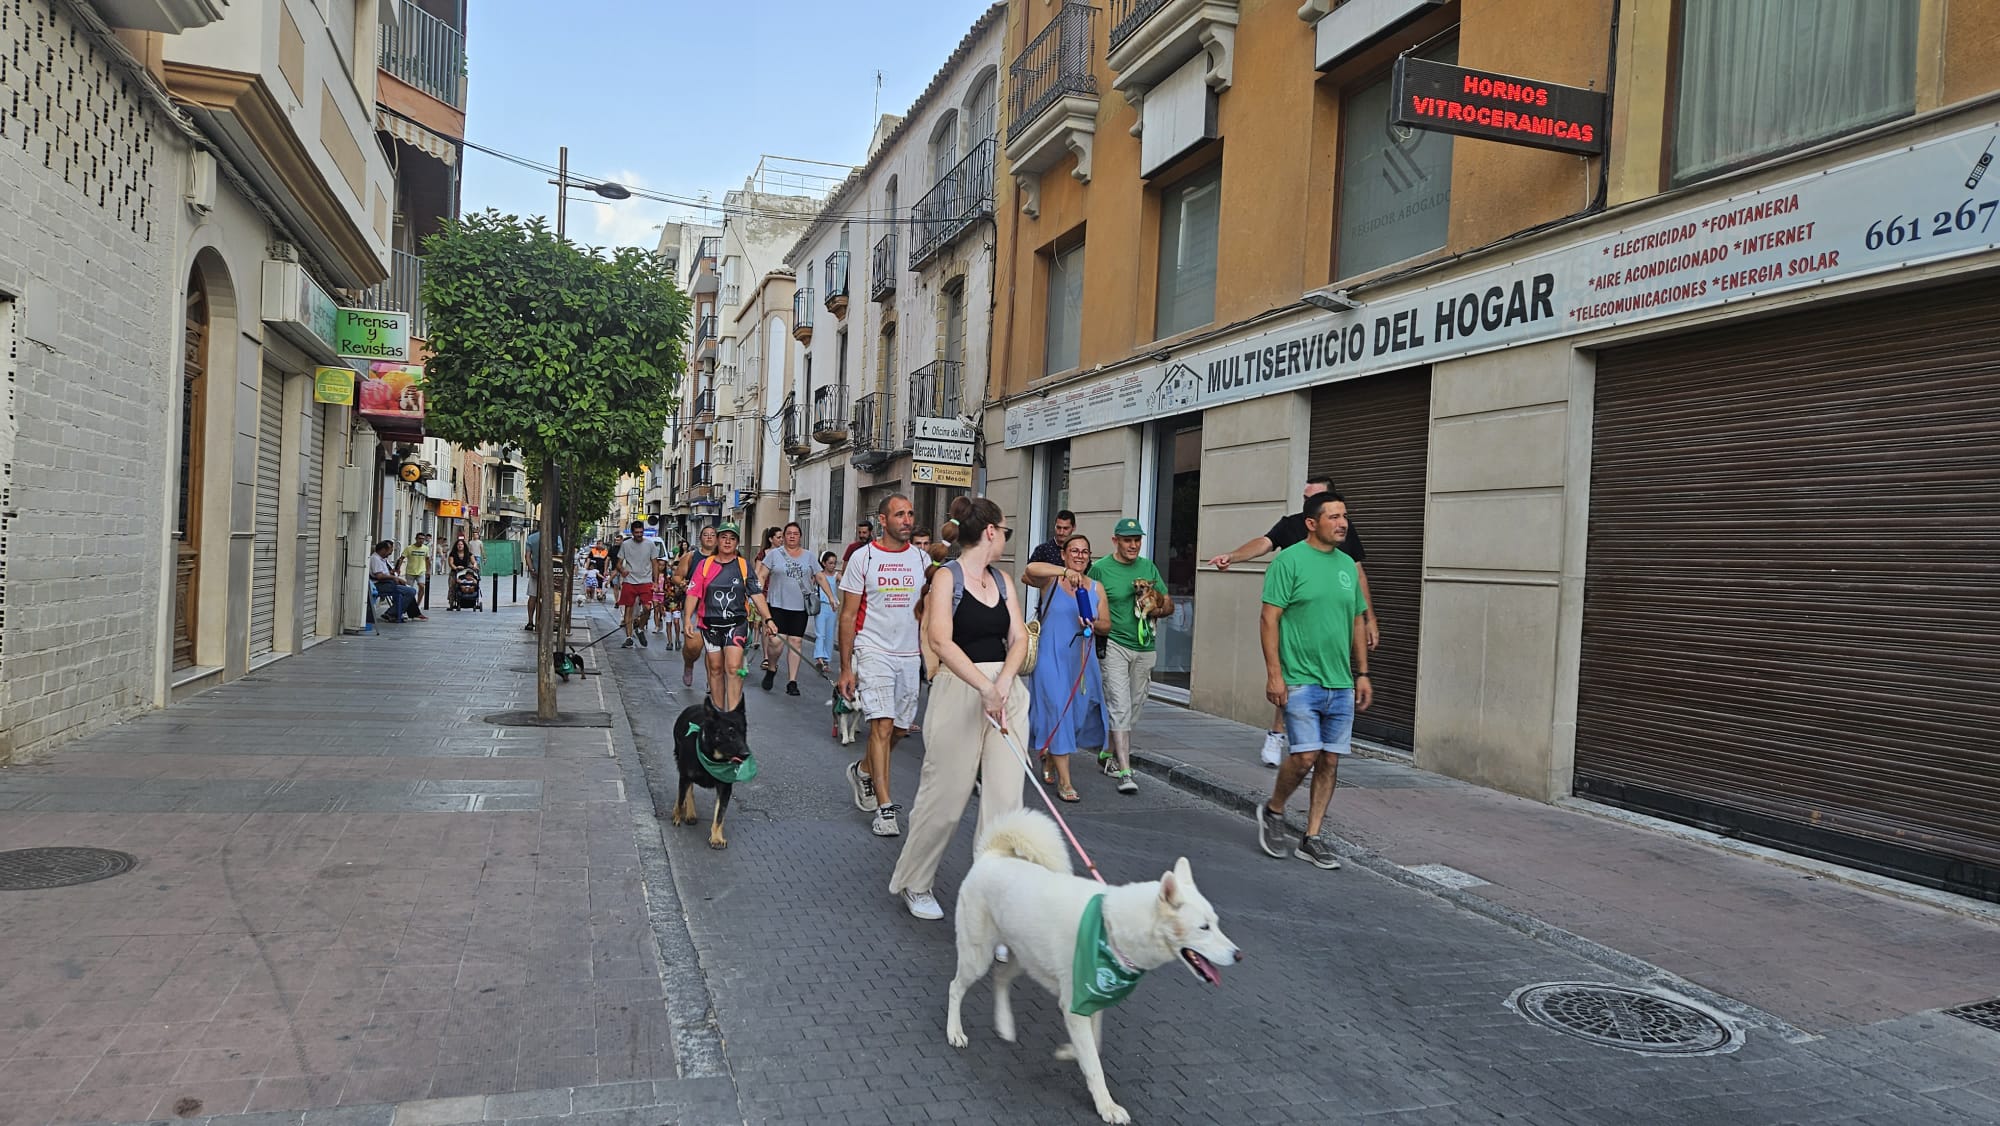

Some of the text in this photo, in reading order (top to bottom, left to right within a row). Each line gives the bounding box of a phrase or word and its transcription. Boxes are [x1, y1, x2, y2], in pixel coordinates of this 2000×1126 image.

[1463, 75, 1548, 107] HORNOS
[1412, 95, 1594, 143] VITROCERAMICAS
[1865, 198, 2000, 251] 661 267
[1613, 223, 1697, 259] ELECTRICIDAD
[1624, 244, 1729, 285] ACONDICIONADO
[1788, 250, 1840, 277] SOLAR
[347, 312, 398, 330] Prensa
[367, 329, 377, 341] y
[1207, 272, 1555, 393] MULTISERVICIO DEL HOGAR
[341, 340, 404, 357] Revistas
[931, 425, 950, 437] Oficina
[951, 428, 959, 438] del
[914, 442, 963, 461] Mercado Municipal
